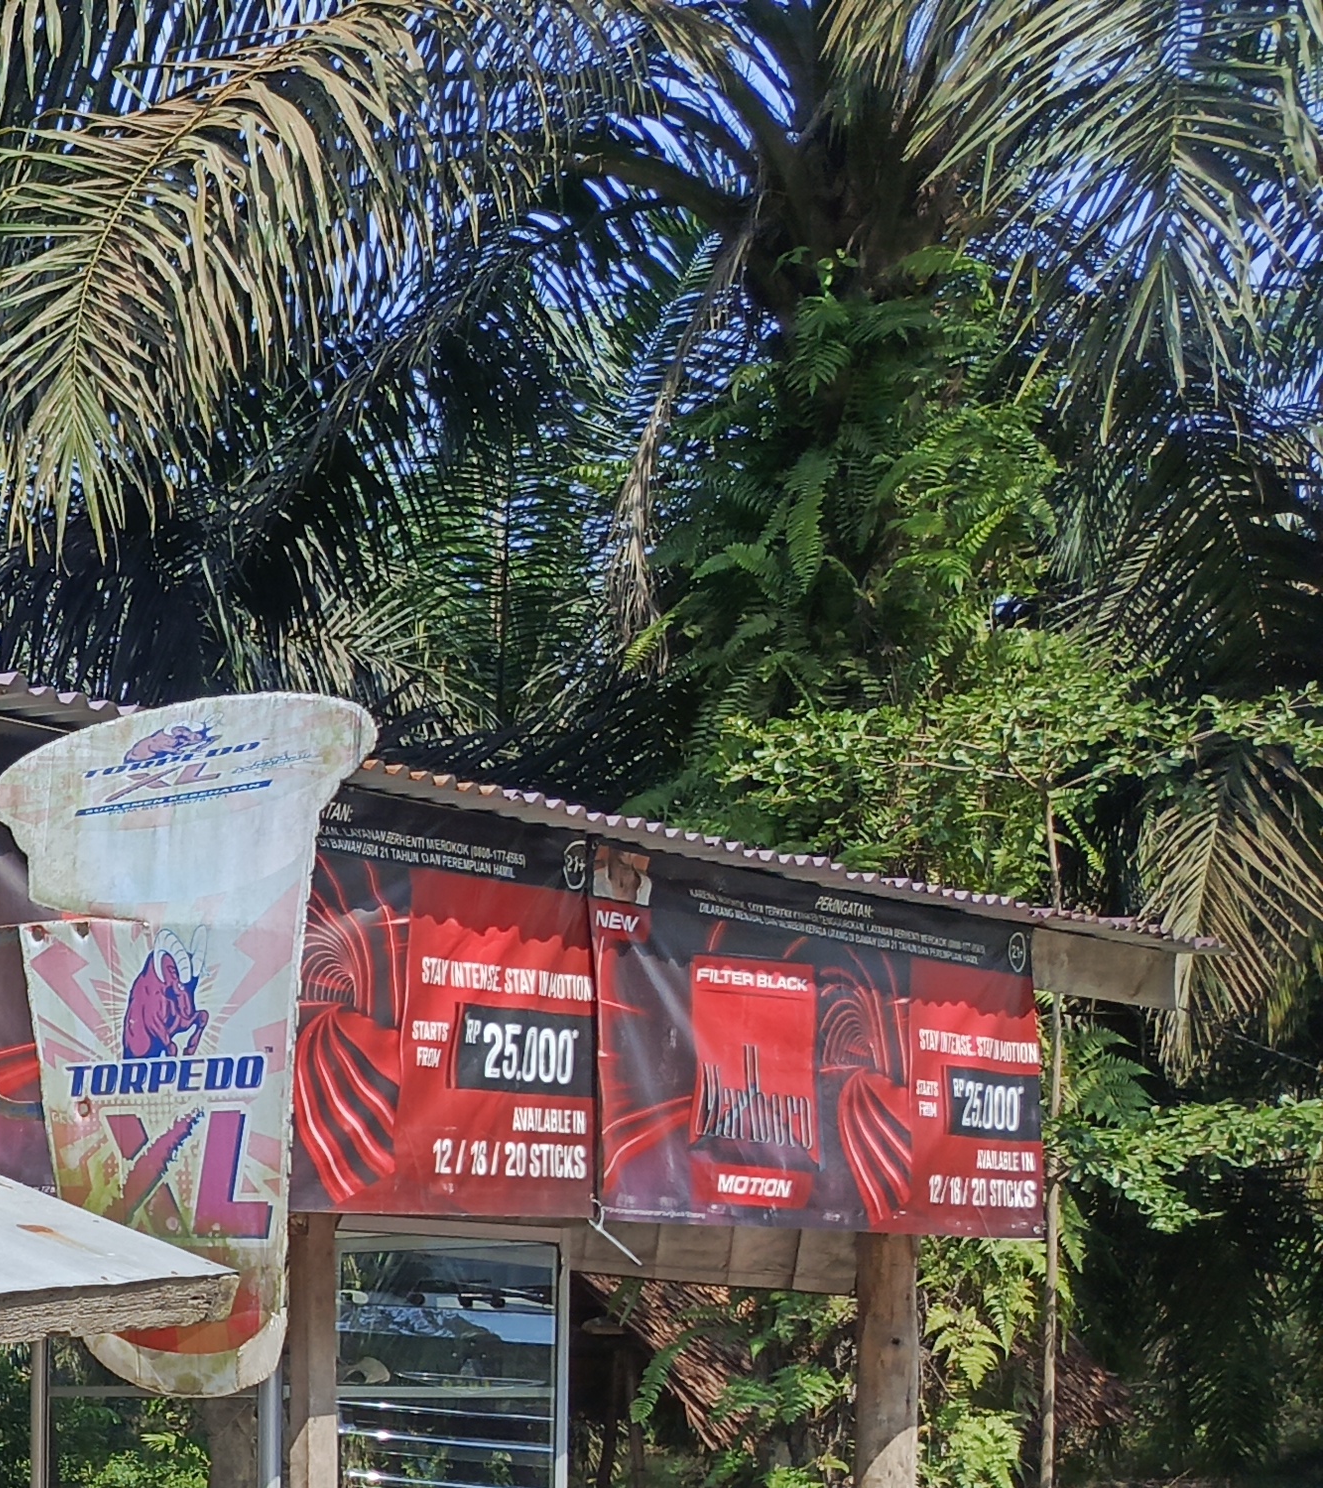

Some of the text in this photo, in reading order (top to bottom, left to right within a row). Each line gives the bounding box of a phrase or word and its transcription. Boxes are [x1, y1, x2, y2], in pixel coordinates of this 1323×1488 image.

[83, 741, 262, 779] TORPEDO
[104, 762, 220, 803] XL
[390, 848, 419, 863] TAHUN
[595, 909, 639, 933] NEW
[421, 956, 448, 986] STAY
[450, 960, 502, 993] INTENSE.
[504, 967, 537, 995] STAY
[696, 967, 809, 993] FILTER BLACK
[412, 1020, 449, 1042] STARTS
[465, 1018, 481, 1044] RP
[918, 1028, 940, 1052] STAY
[416, 1046, 441, 1068] FROM
[66, 1056, 266, 1098] TORPEDO
[953, 1078, 965, 1098] RP
[695, 1043, 813, 1150] Marlboro
[512, 1106, 586, 1134] AVAILABLE IN
[433, 1139, 452, 1175] 12
[504, 1142, 528, 1177] 20
[528, 1143, 587, 1180] STICKS
[976, 1149, 1035, 1172] AVAILABLE IN
[102, 1107, 274, 1240] XL
[717, 1173, 793, 1198] MOTION
[929, 1174, 943, 1204] 12
[971, 1178, 986, 1206] 20
[989, 1179, 1037, 1208] STICKS
